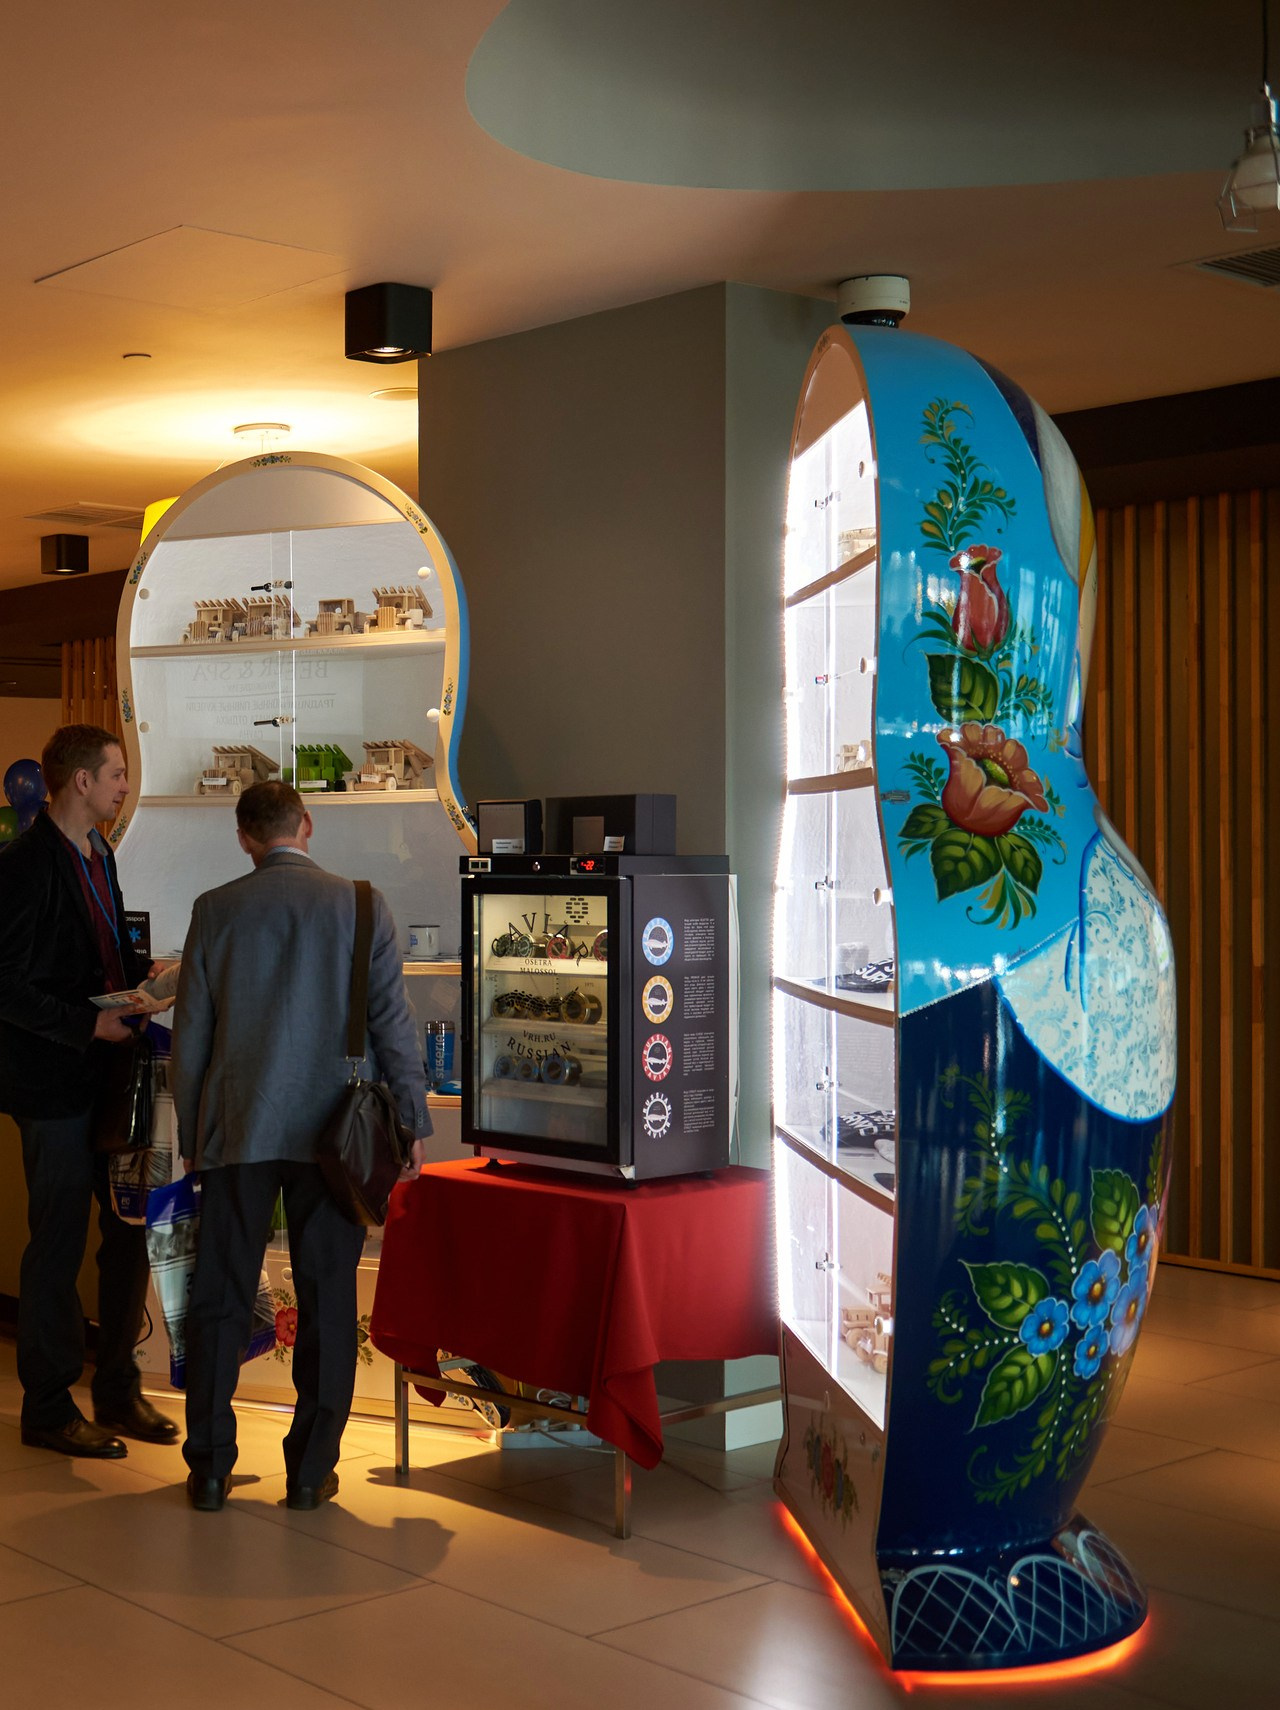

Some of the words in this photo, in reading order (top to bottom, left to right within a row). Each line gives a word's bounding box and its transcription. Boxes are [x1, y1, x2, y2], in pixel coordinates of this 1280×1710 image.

[524, 958, 553, 967] OSETRA
[519, 967, 558, 976] MALOSSOL
[522, 1030, 557, 1043] VRH.RU
[507, 1036, 572, 1061] RUSSIAN
[642, 1092, 672, 1114] RUSSIAN
[643, 1122, 671, 1139] CAVIAR
